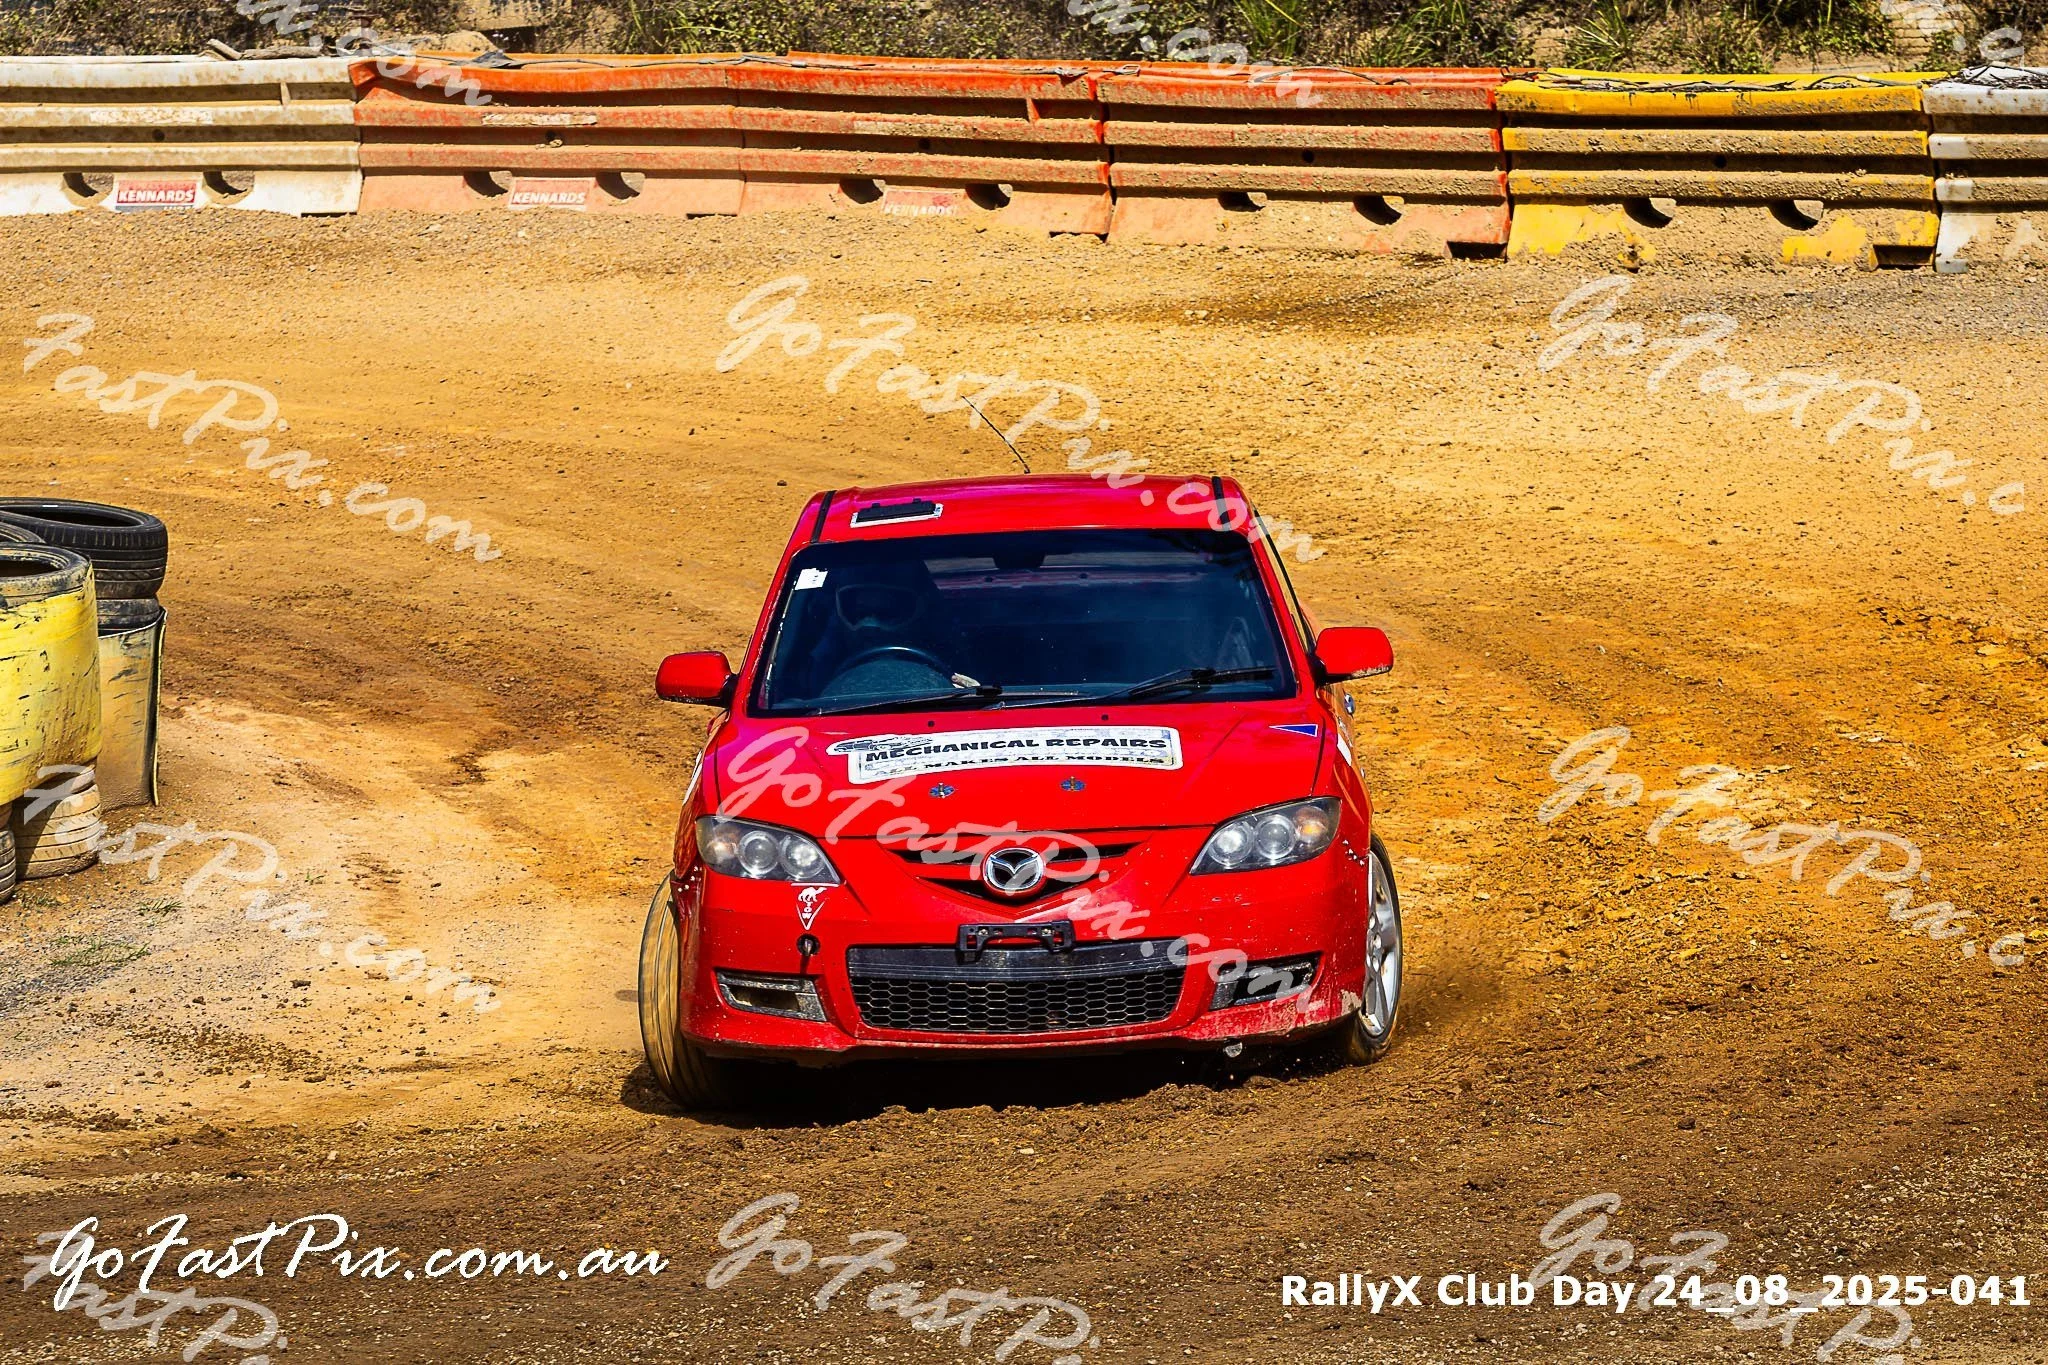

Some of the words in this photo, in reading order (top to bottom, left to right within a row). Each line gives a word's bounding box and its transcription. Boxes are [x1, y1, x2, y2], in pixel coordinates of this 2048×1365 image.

[118, 189, 195, 202] KENNARDS
[512, 191, 587, 204] KENNARDS
[866, 738, 1040, 762] MECHANICAL
[1045, 738, 1167, 748] REPAIRS
[924, 757, 1009, 769] MAKES
[1066, 756, 1165, 765] MODELS
